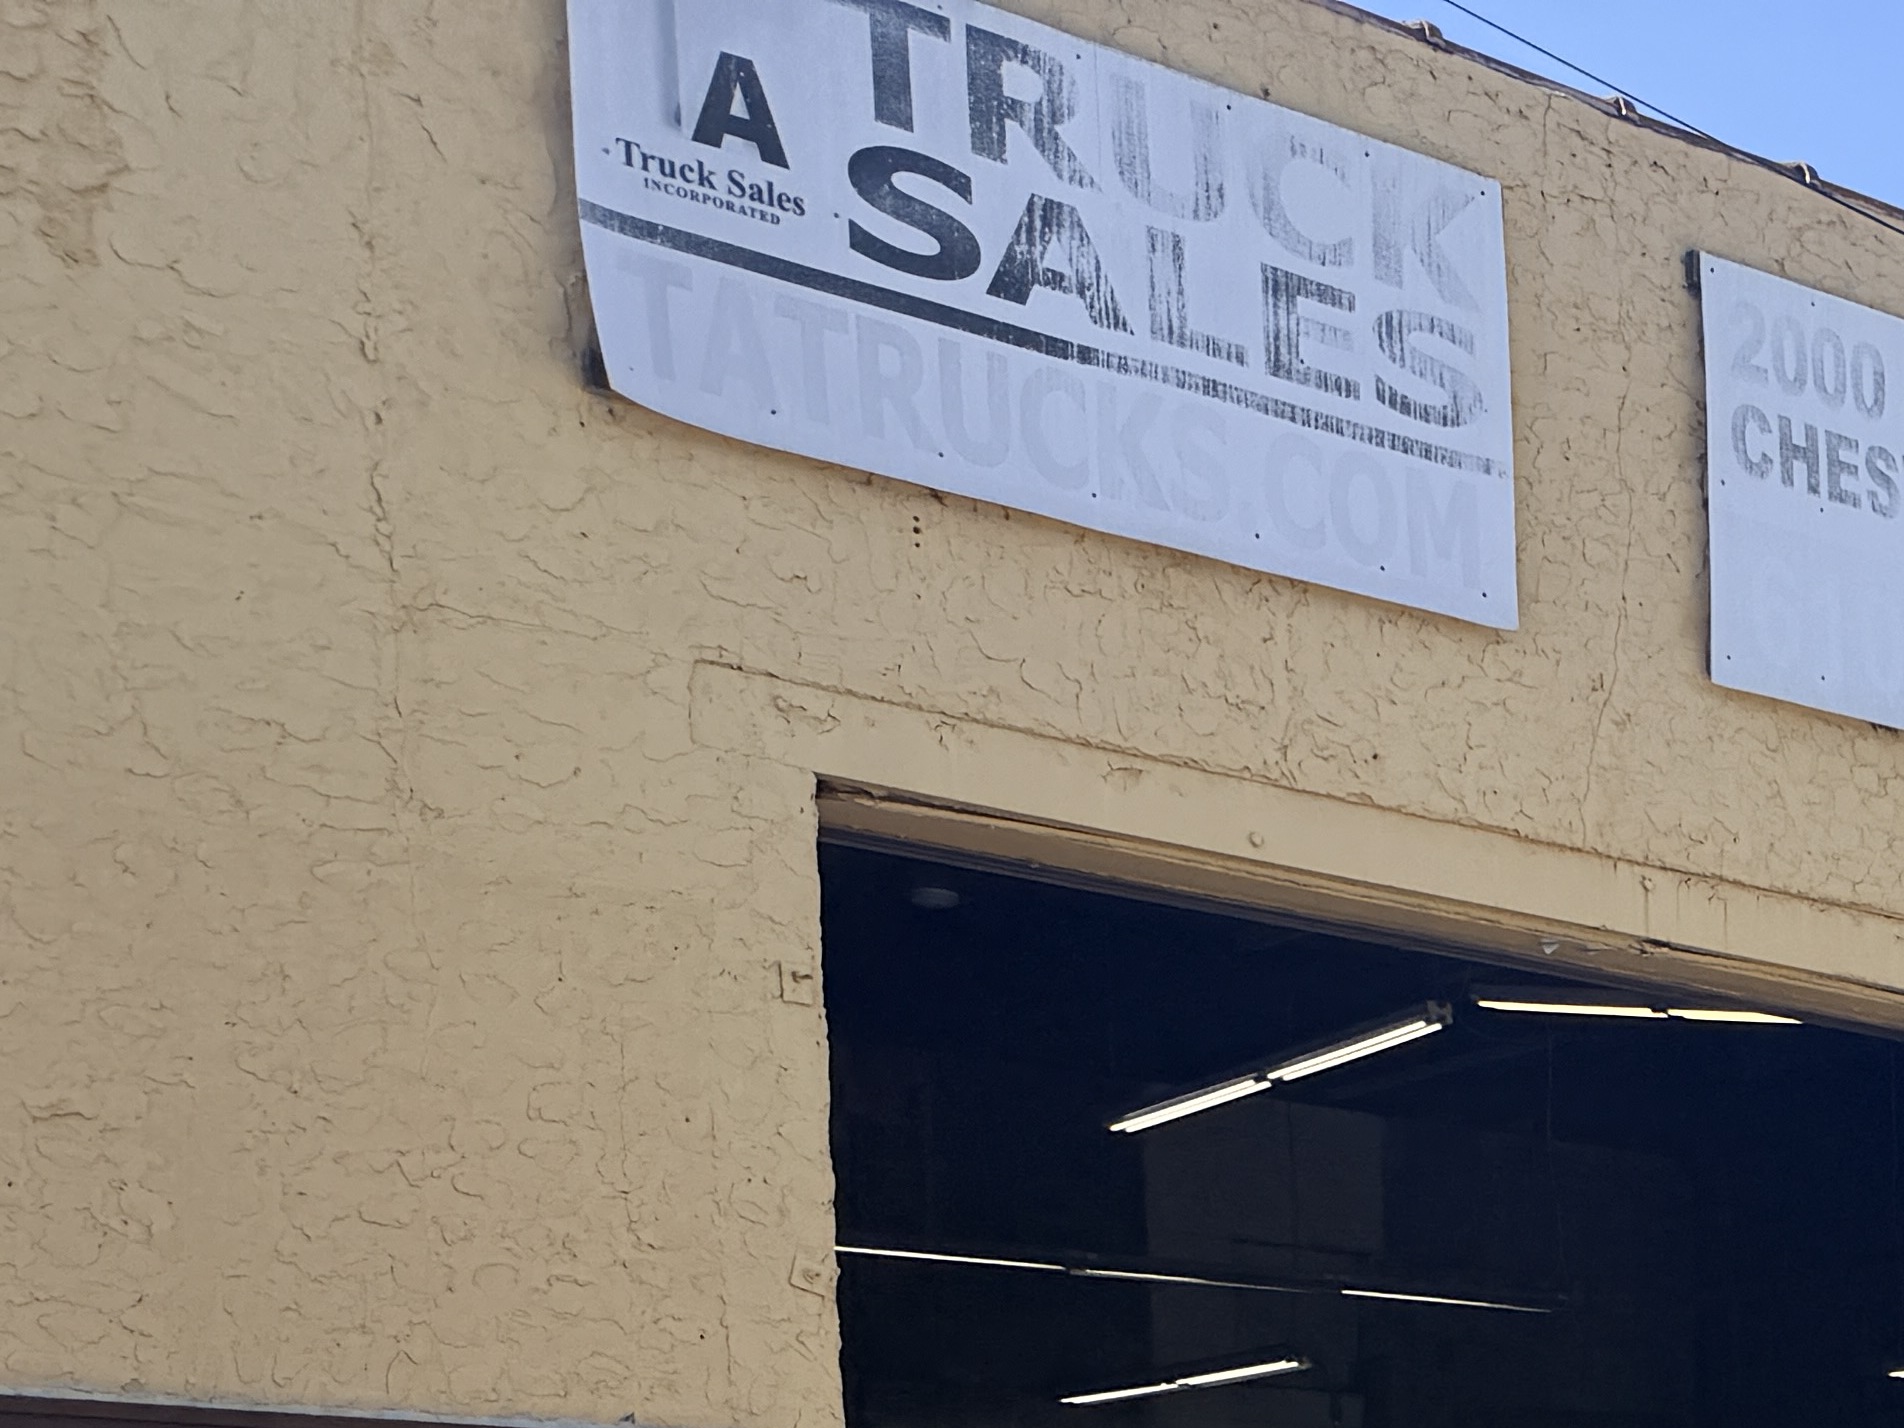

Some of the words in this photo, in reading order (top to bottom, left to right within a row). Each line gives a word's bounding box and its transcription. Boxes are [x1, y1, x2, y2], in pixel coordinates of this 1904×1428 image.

[615, 137, 717, 190] Truck
[727, 169, 806, 216] Sales
[643, 177, 781, 226] INCORPORATED
[827, 0, 1485, 316] TRUCK
[846, 144, 1487, 430] SALES
[1729, 300, 1886, 422] 2000
